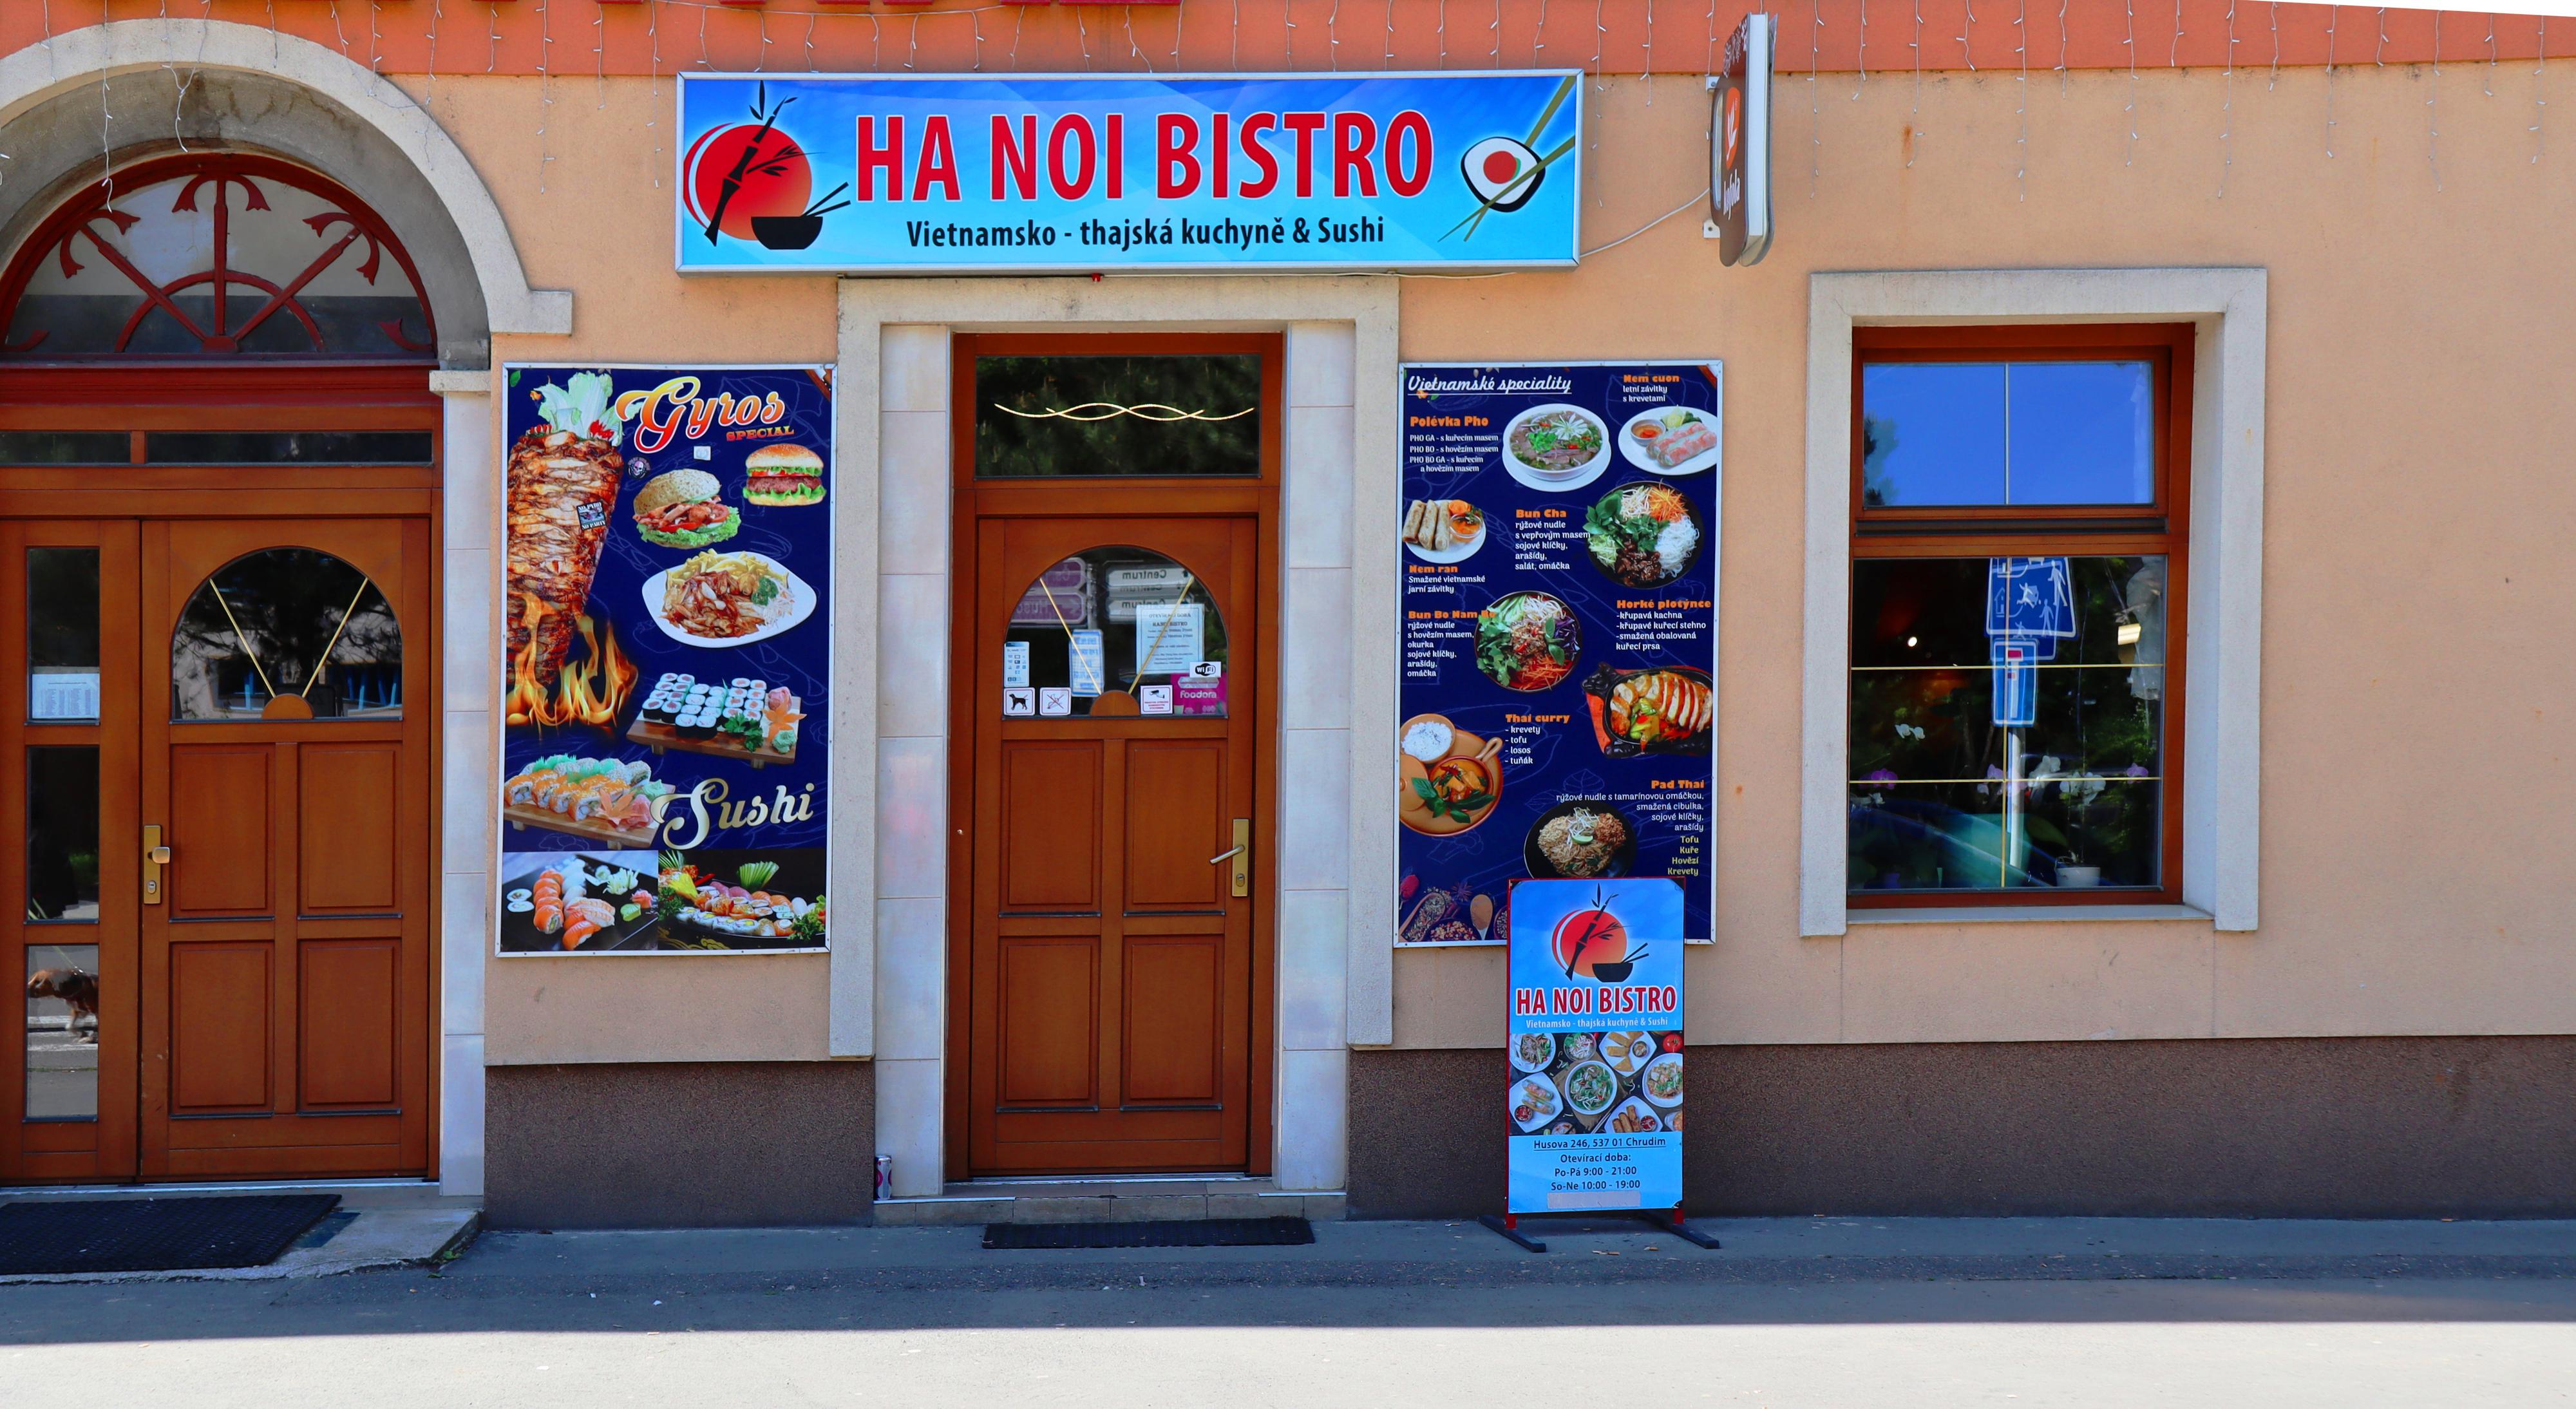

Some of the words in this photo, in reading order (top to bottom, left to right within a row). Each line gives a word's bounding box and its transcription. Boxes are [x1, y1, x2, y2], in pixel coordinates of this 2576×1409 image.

[855, 114, 962, 202] HA
[990, 112, 1121, 201] NOI
[1158, 110, 1433, 200] BISTRO
[907, 220, 1056, 247] Vietnamsko
[1080, 218, 1172, 249] thajská
[1182, 217, 1285, 247] kuchyně
[1292, 220, 1311, 243] &
[1318, 216, 1384, 243] Sushi
[1408, 375, 1495, 392] Vietnamské
[1497, 375, 1571, 393] speciality
[1641, 385, 1667, 395] závitky
[614, 376, 785, 453] Gyros
[1410, 416, 1461, 427] Polévka
[1464, 416, 1488, 426] Pho
[726, 426, 794, 441] SPECIAL
[1517, 509, 1540, 518] Bun
[1515, 521, 1542, 530] rýžové
[1522, 531, 1560, 540] vepřovým
[1515, 542, 1540, 551] sojové
[1542, 542, 1567, 551] klíčky,
[1515, 552, 1547, 561] arašídy,
[1408, 585, 1426, 594] jarní
[1428, 585, 1454, 594] závitky
[1658, 600, 1710, 610] plotýnce
[1617, 612, 1652, 620] -křupavá
[1408, 622, 1432, 630] rýžové
[1616, 622, 1651, 630] -křupavé
[1408, 650, 1430, 659] sojové
[1408, 660, 1437, 668] arašídy,
[1180, 690, 1217, 699] foodora
[1506, 714, 1531, 723] Thai
[1511, 726, 1540, 734] krevety
[1678, 780, 1704, 788] Thai
[1557, 793, 1582, 802] rýžové
[650, 778, 815, 849] Sushi
[1652, 813, 1676, 822] sojové
[1679, 813, 1703, 822] klíčky,
[1675, 823, 1703, 832] arašídy
[1668, 867, 1698, 876] Krevety
[1517, 989, 1546, 1015] HA
[1553, 988, 1591, 1014] NOI
[1598, 986, 1676, 1014] BISTRO
[1526, 1019, 1570, 1028] Vietnamsko
[1578, 1019, 1605, 1028] thajská
[1607, 1018, 1638, 1027] kuchyně
[1649, 1017, 1668, 1025] Sushi
[1534, 1140, 1567, 1149] Husova
[1571, 1140, 1590, 1149] 246,
[1626, 1137, 1665, 1146] Chrudim
[1560, 1154, 1602, 1163] Otevírací
[1605, 1153, 1631, 1162] doba:
[1555, 1167, 1580, 1177] Po-Pá
[1583, 1167, 1603, 1176] 9:00
[1551, 1182, 1578, 1190] So-Ne
[1582, 1181, 1605, 1189] 10:00
[1616, 1180, 1640, 1189] 19:00
